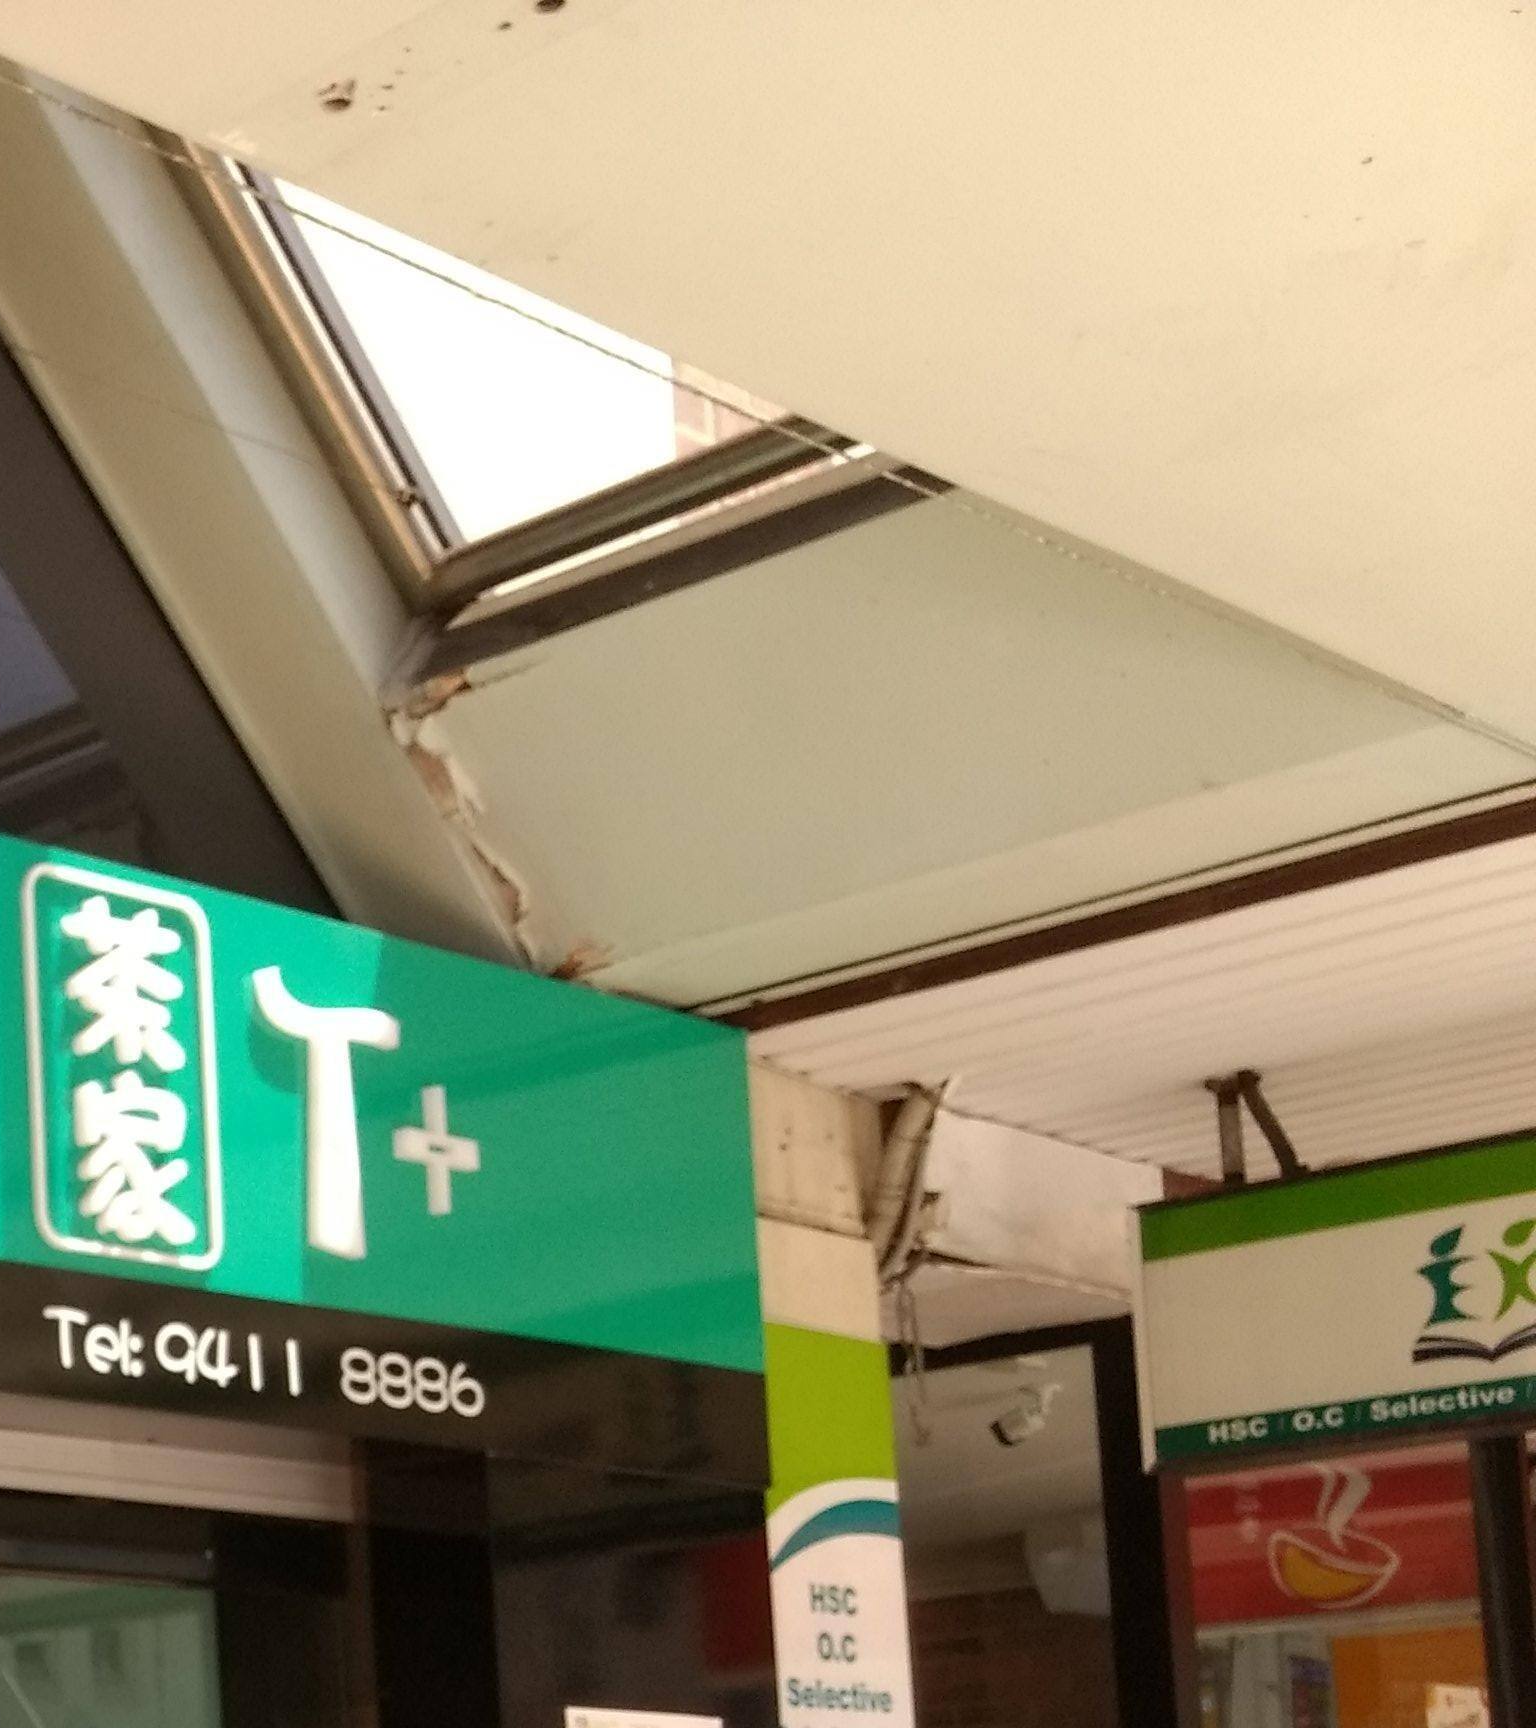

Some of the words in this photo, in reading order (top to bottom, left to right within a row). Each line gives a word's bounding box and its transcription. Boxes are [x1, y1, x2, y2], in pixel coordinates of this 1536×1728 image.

[61, 896, 196, 1244] 茶家
[154, 1319, 303, 1397] 9411
[339, 1346, 486, 1418] 8886
[1208, 1417, 1269, 1446] HSC
[1292, 1405, 1344, 1433] O.C
[1370, 1384, 1515, 1424] Selective
[810, 1582, 857, 1615] HSC
[788, 1677, 892, 1713] Selective
